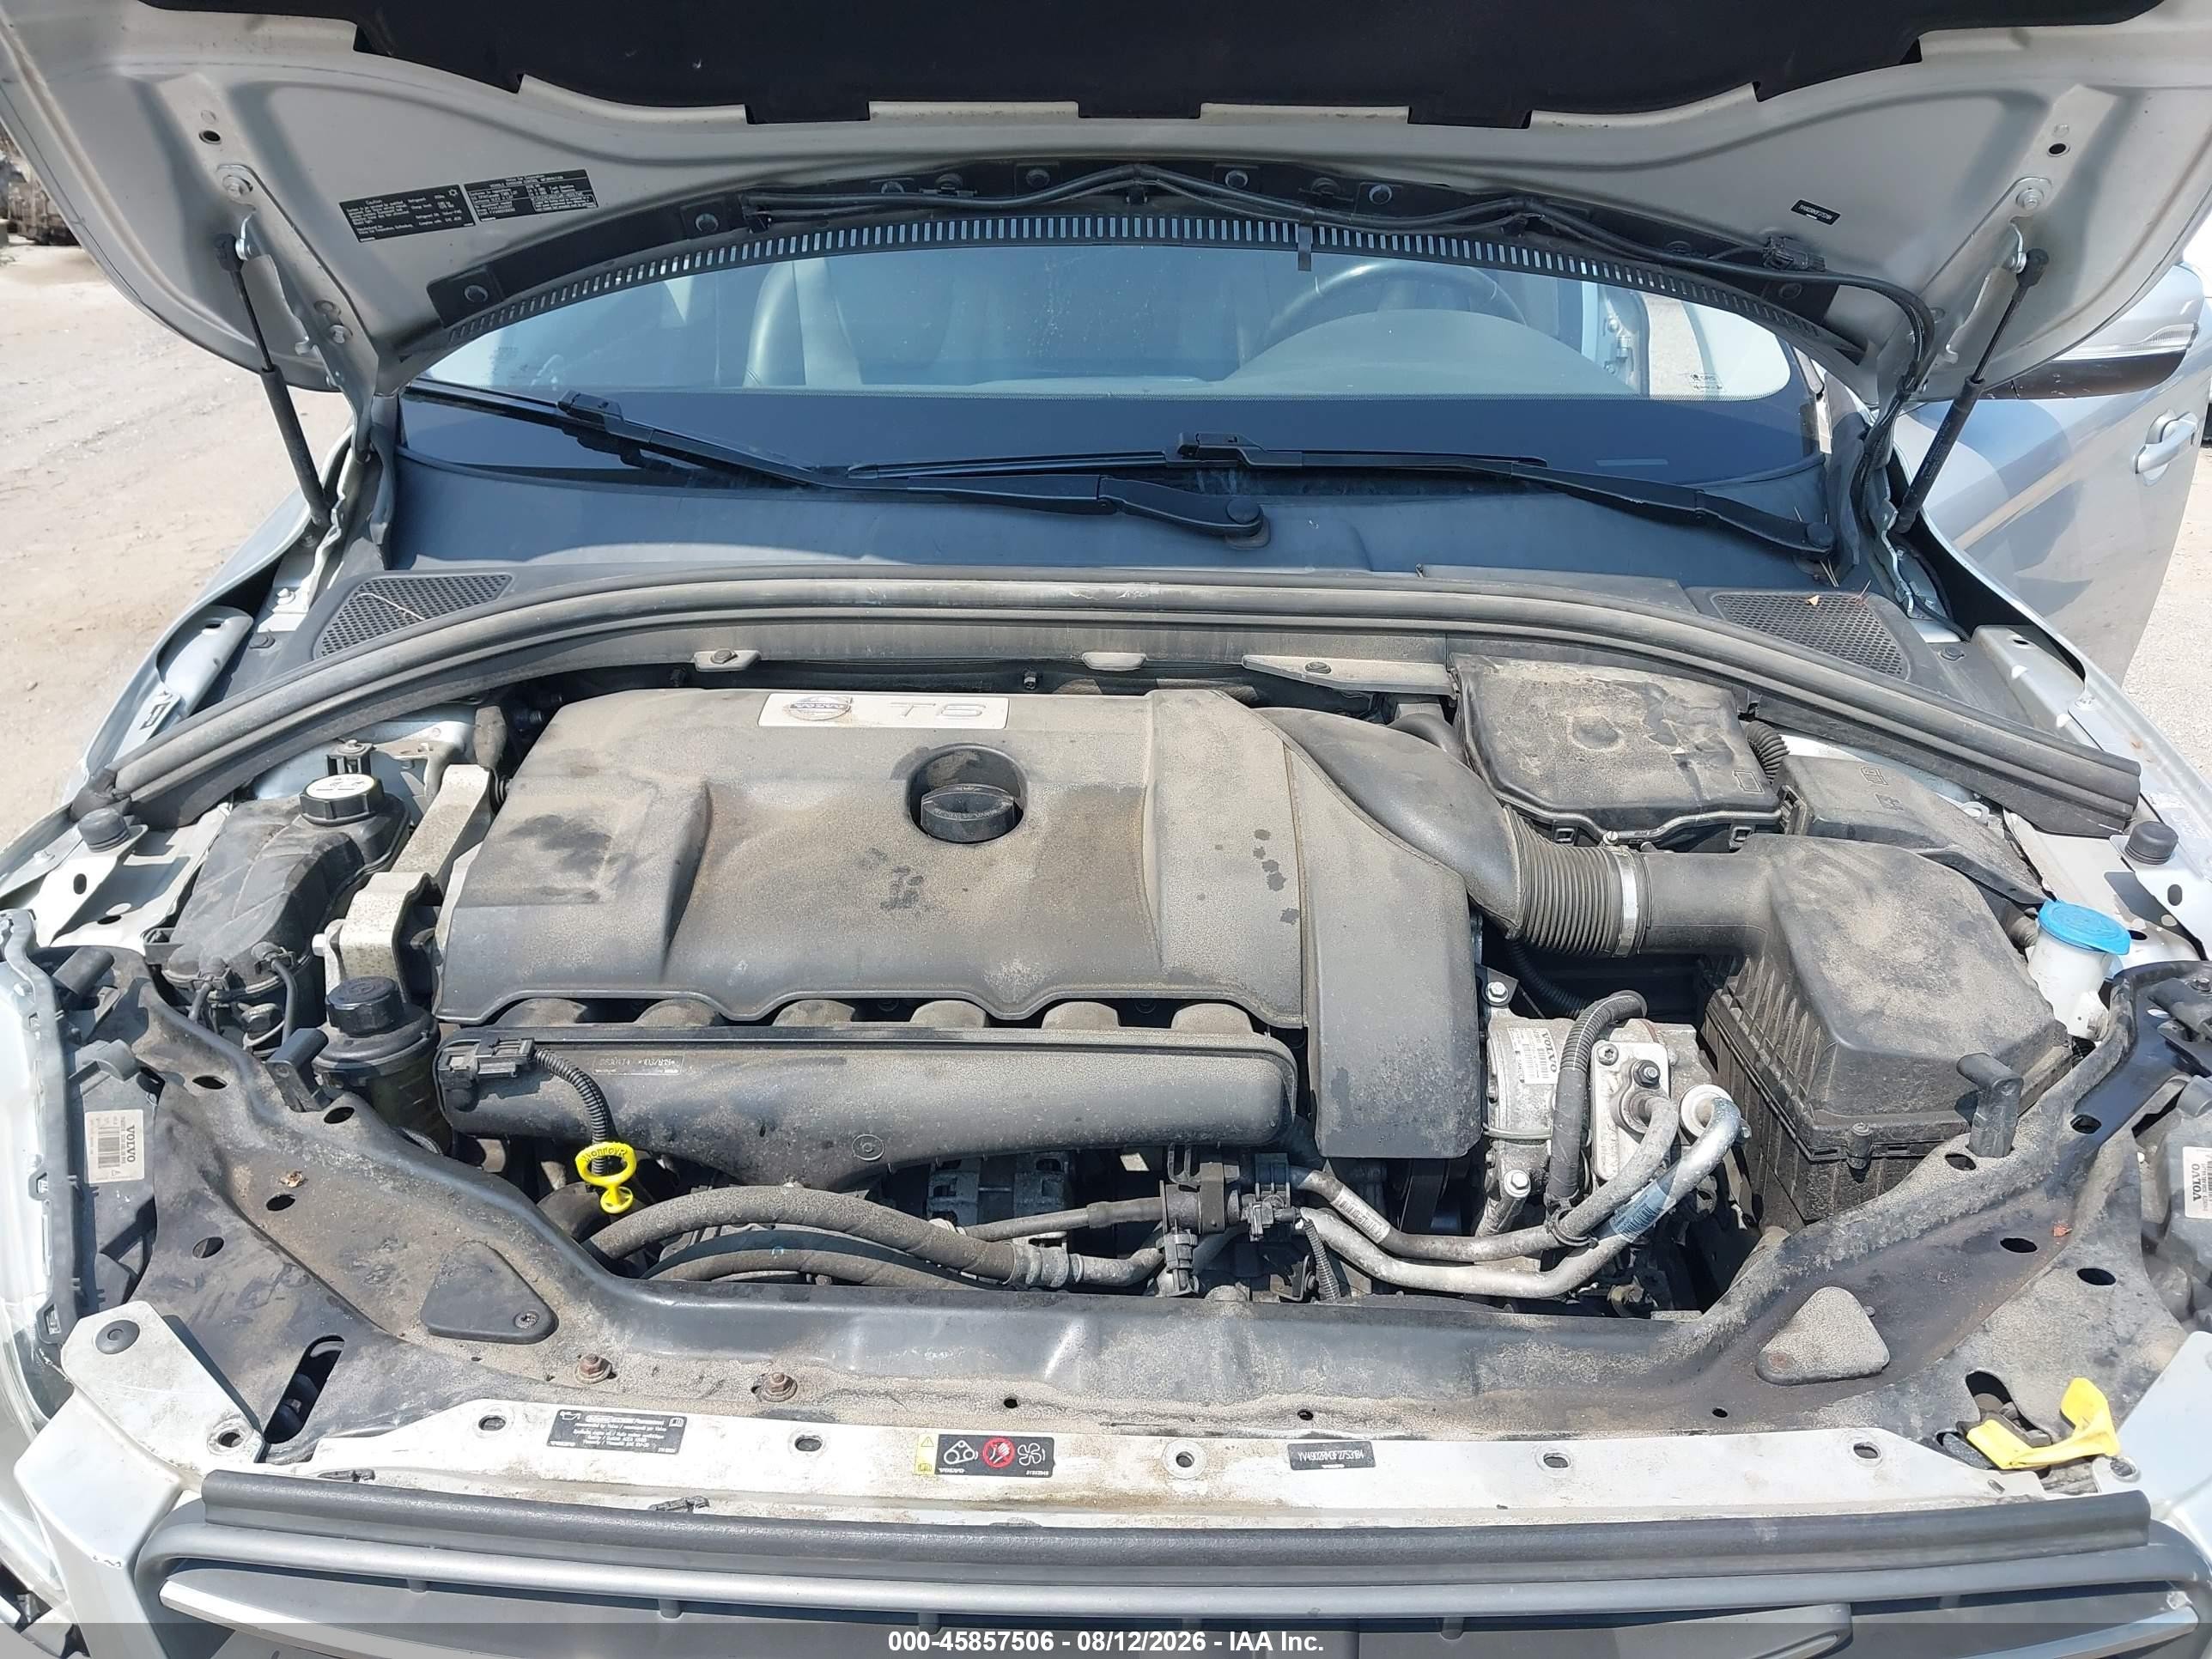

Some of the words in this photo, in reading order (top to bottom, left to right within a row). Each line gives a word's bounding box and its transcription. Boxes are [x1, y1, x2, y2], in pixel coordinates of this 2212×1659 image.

[1541, 1032, 1558, 1073] VOLVO
[126, 1125, 136, 1163] VOLVO
[2191, 1164, 2202, 1202] VOLVO
